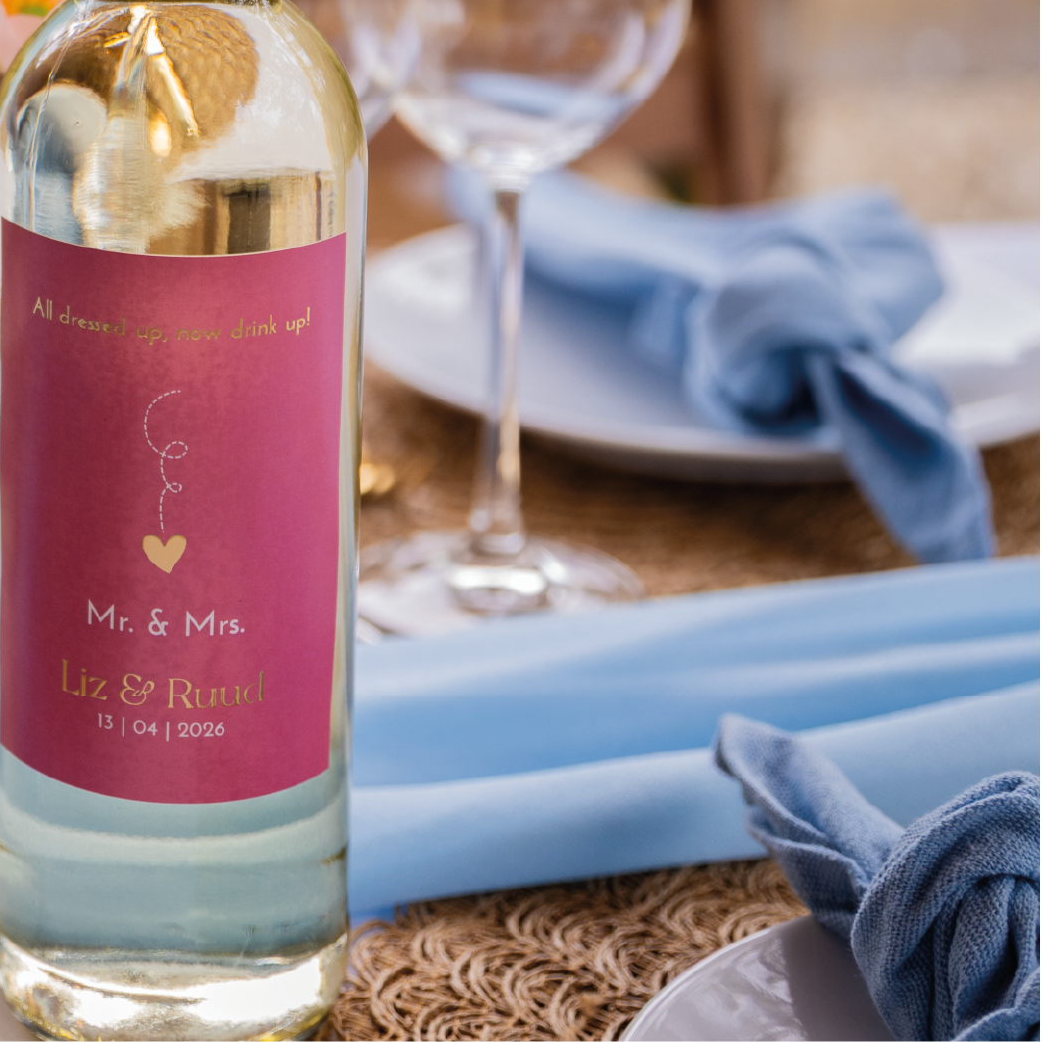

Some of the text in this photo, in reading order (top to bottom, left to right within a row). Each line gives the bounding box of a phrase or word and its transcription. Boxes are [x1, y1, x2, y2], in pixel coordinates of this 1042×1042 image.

[32, 296, 311, 346] All dressed up, now drink up!
[87, 598, 246, 637] Mr. & Mrs.
[62, 658, 265, 709] Liz & Ruud
[98, 713, 114, 730] 13
[132, 720, 158, 737] 04
[177, 721, 225, 738] 2026
